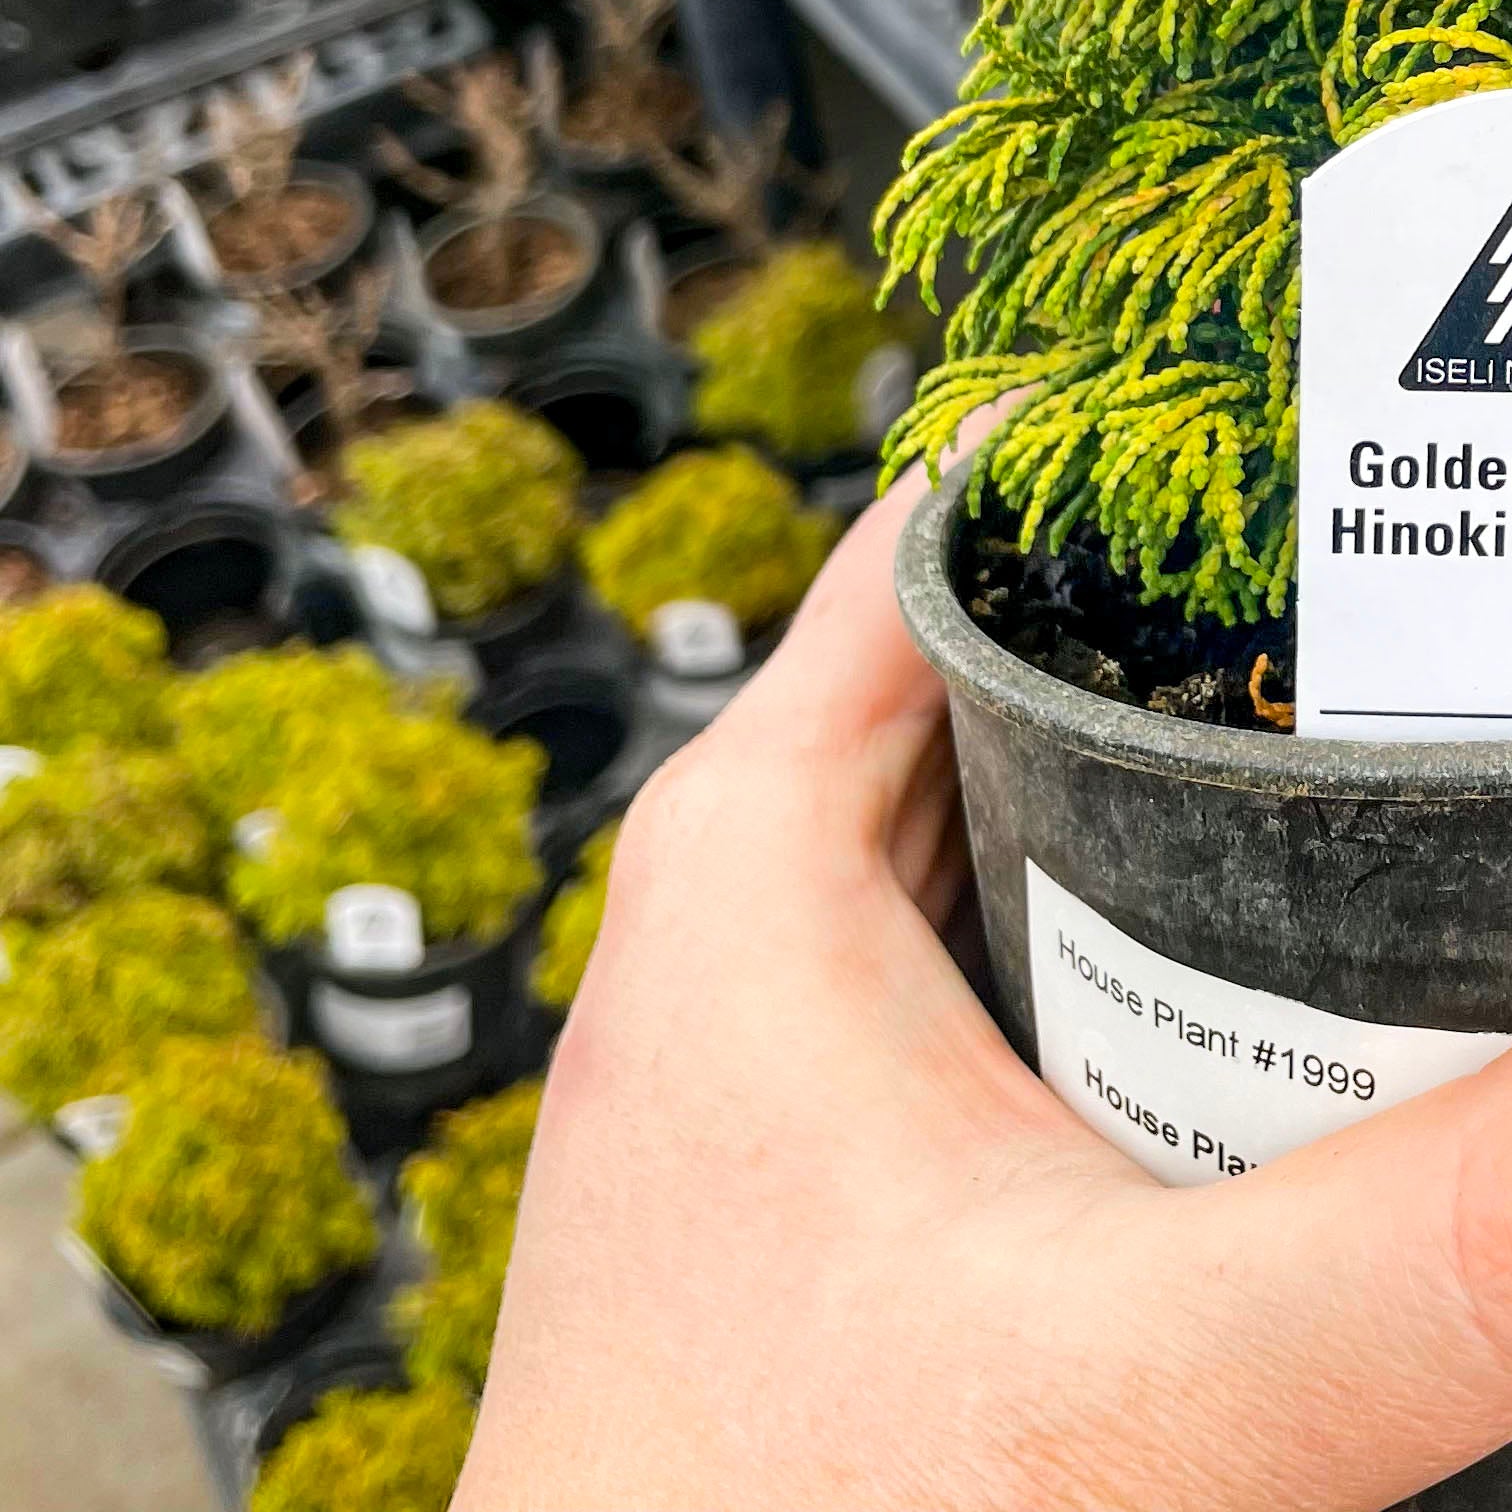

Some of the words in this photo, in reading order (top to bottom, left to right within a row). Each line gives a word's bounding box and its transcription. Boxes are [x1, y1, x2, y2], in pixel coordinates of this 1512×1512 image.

[1415, 357, 1495, 387] ISELI
[1331, 507, 1506, 558] Hinoki
[1057, 929, 1143, 1017] House
[1153, 997, 1240, 1058] Plant
[1252, 1039, 1376, 1101] #1999
[1085, 1058, 1179, 1147] House
[1192, 1128, 1258, 1177] Pla
